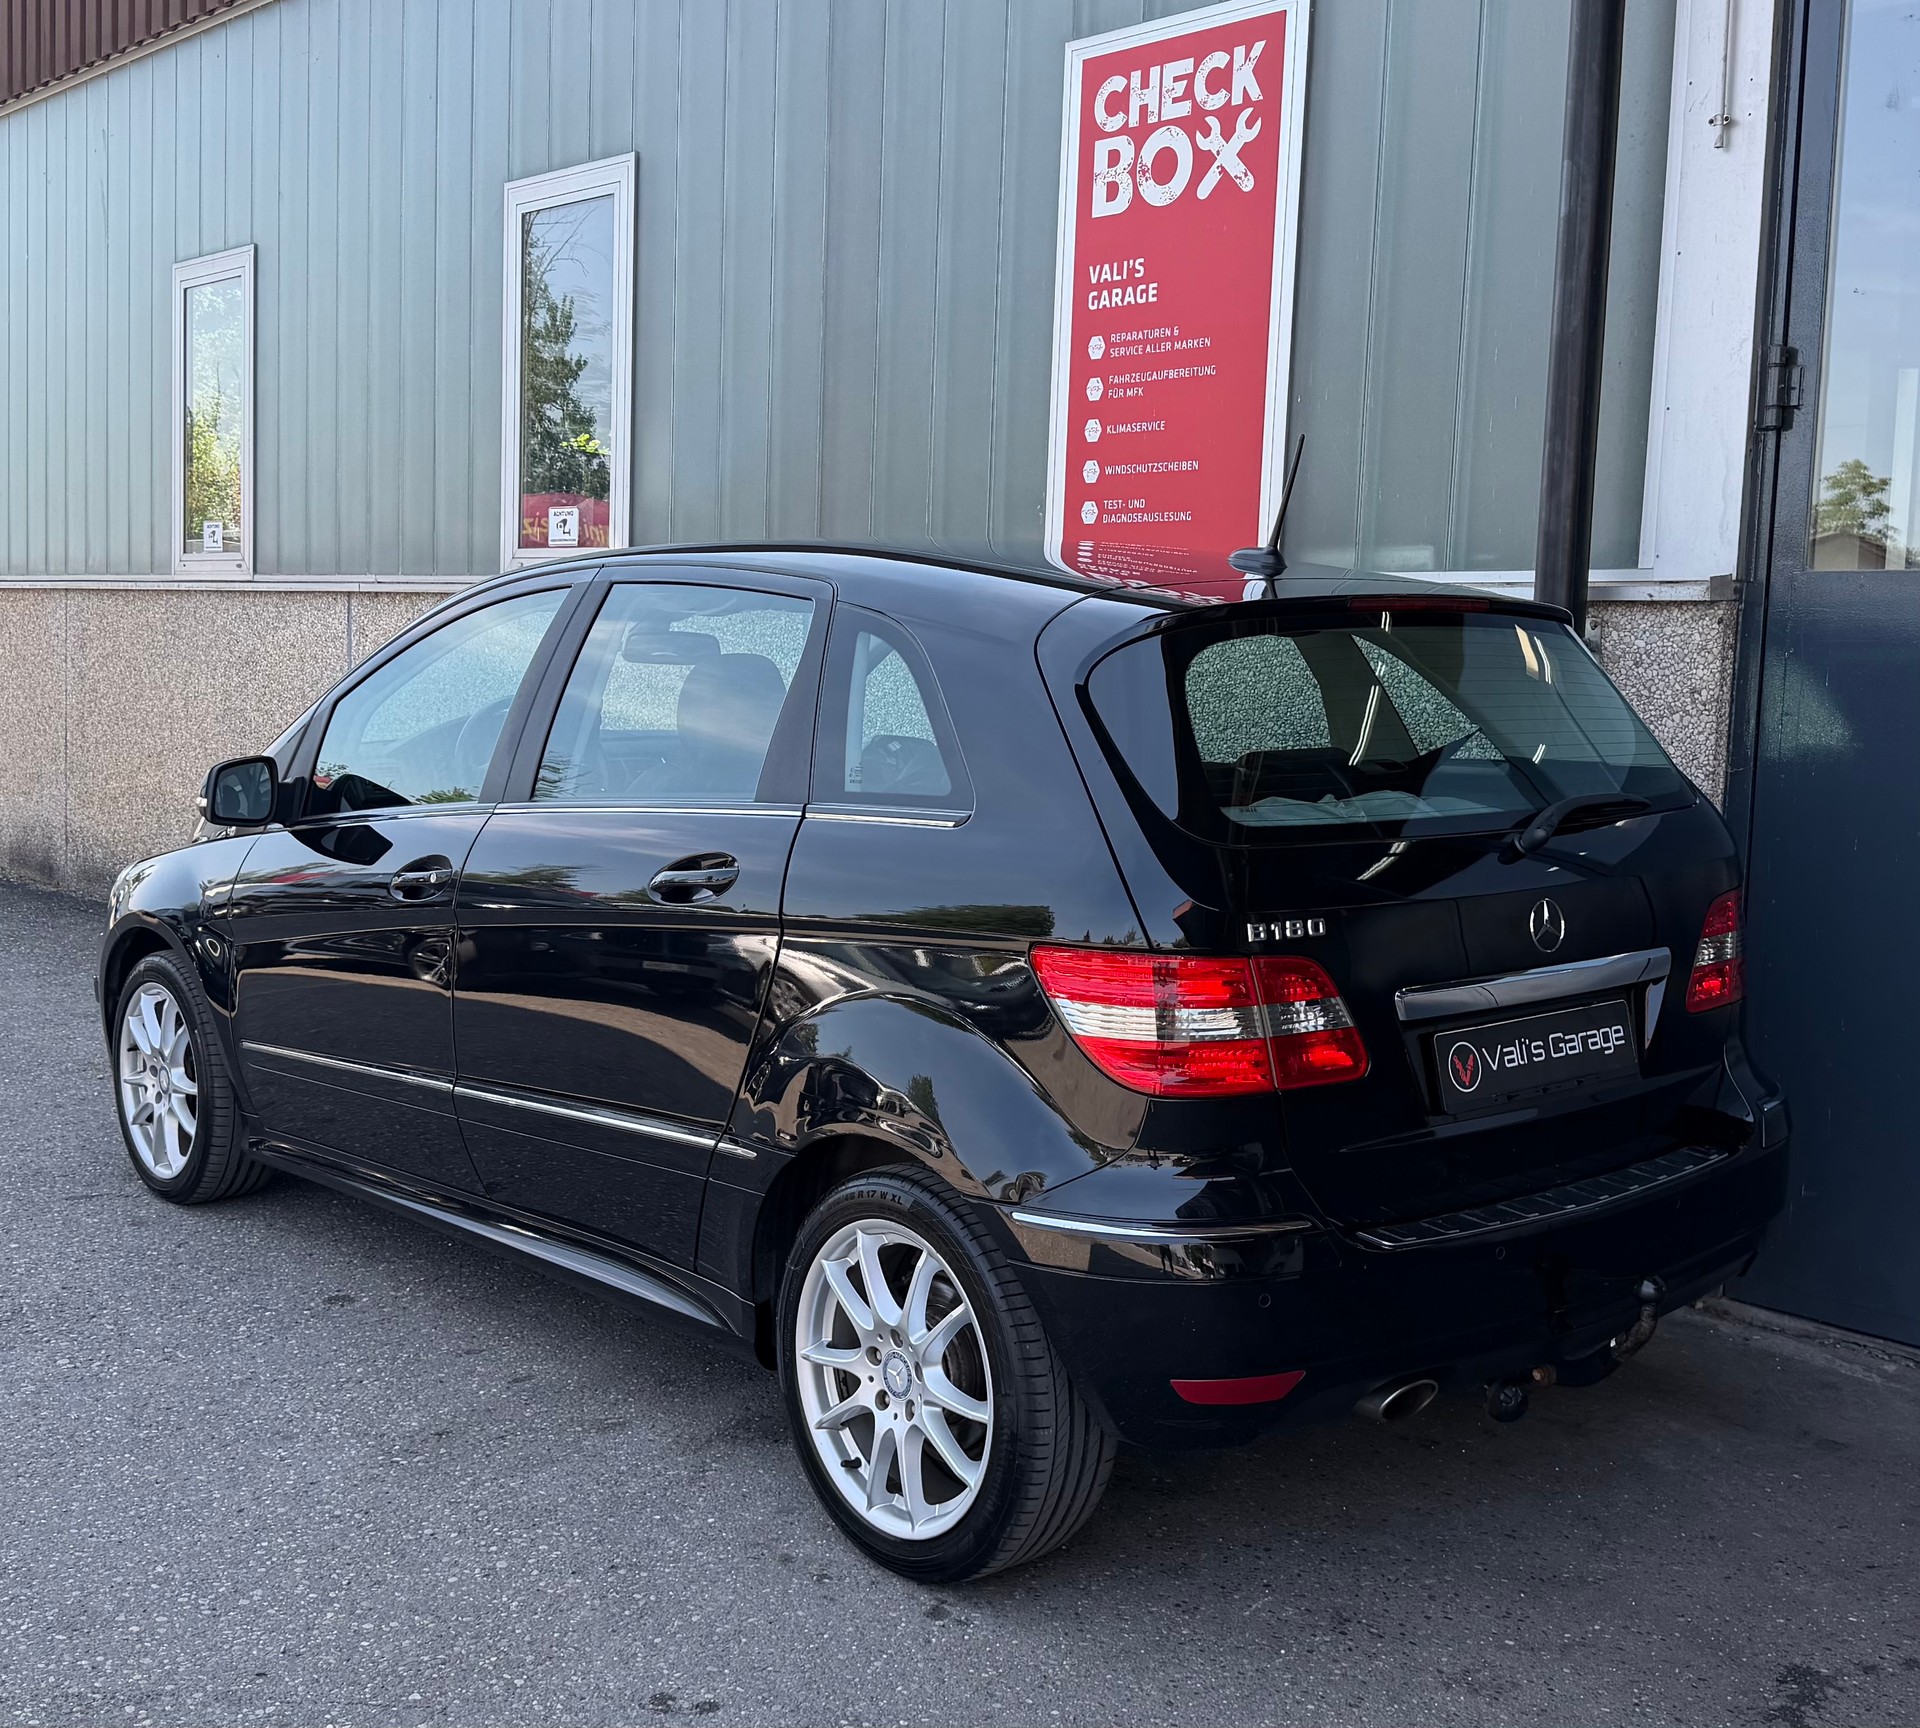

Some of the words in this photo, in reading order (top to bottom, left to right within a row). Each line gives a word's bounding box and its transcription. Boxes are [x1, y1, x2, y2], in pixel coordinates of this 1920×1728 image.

[1094, 40, 1266, 133] CHECK
[1091, 107, 1262, 218] BOX
[1089, 258, 1145, 284] VALI'S
[1089, 282, 1158, 310] GARAGE
[1110, 327, 1171, 343] REPARATUREN
[1173, 326, 1179, 336] &
[1110, 345, 1143, 358] SERVICE
[1145, 341, 1172, 353] ALLER
[1174, 337, 1211, 350] MARKEN
[1108, 365, 1216, 385] FAHRZEUGAUFBEREITUNG
[1108, 387, 1124, 399] FÜR
[1126, 387, 1144, 397] MFK
[1106, 421, 1165, 434] KLIMASERVICE
[1104, 460, 1199, 475] WINDSCHUTZSCHEIBEN
[1103, 500, 1126, 510] TEST-
[1128, 499, 1145, 508] UND
[1102, 511, 1192, 524] DIAGNOSEAUSLESUNG
[1481, 1038, 1546, 1071] Vali's
[1548, 1025, 1625, 1058] Garage
